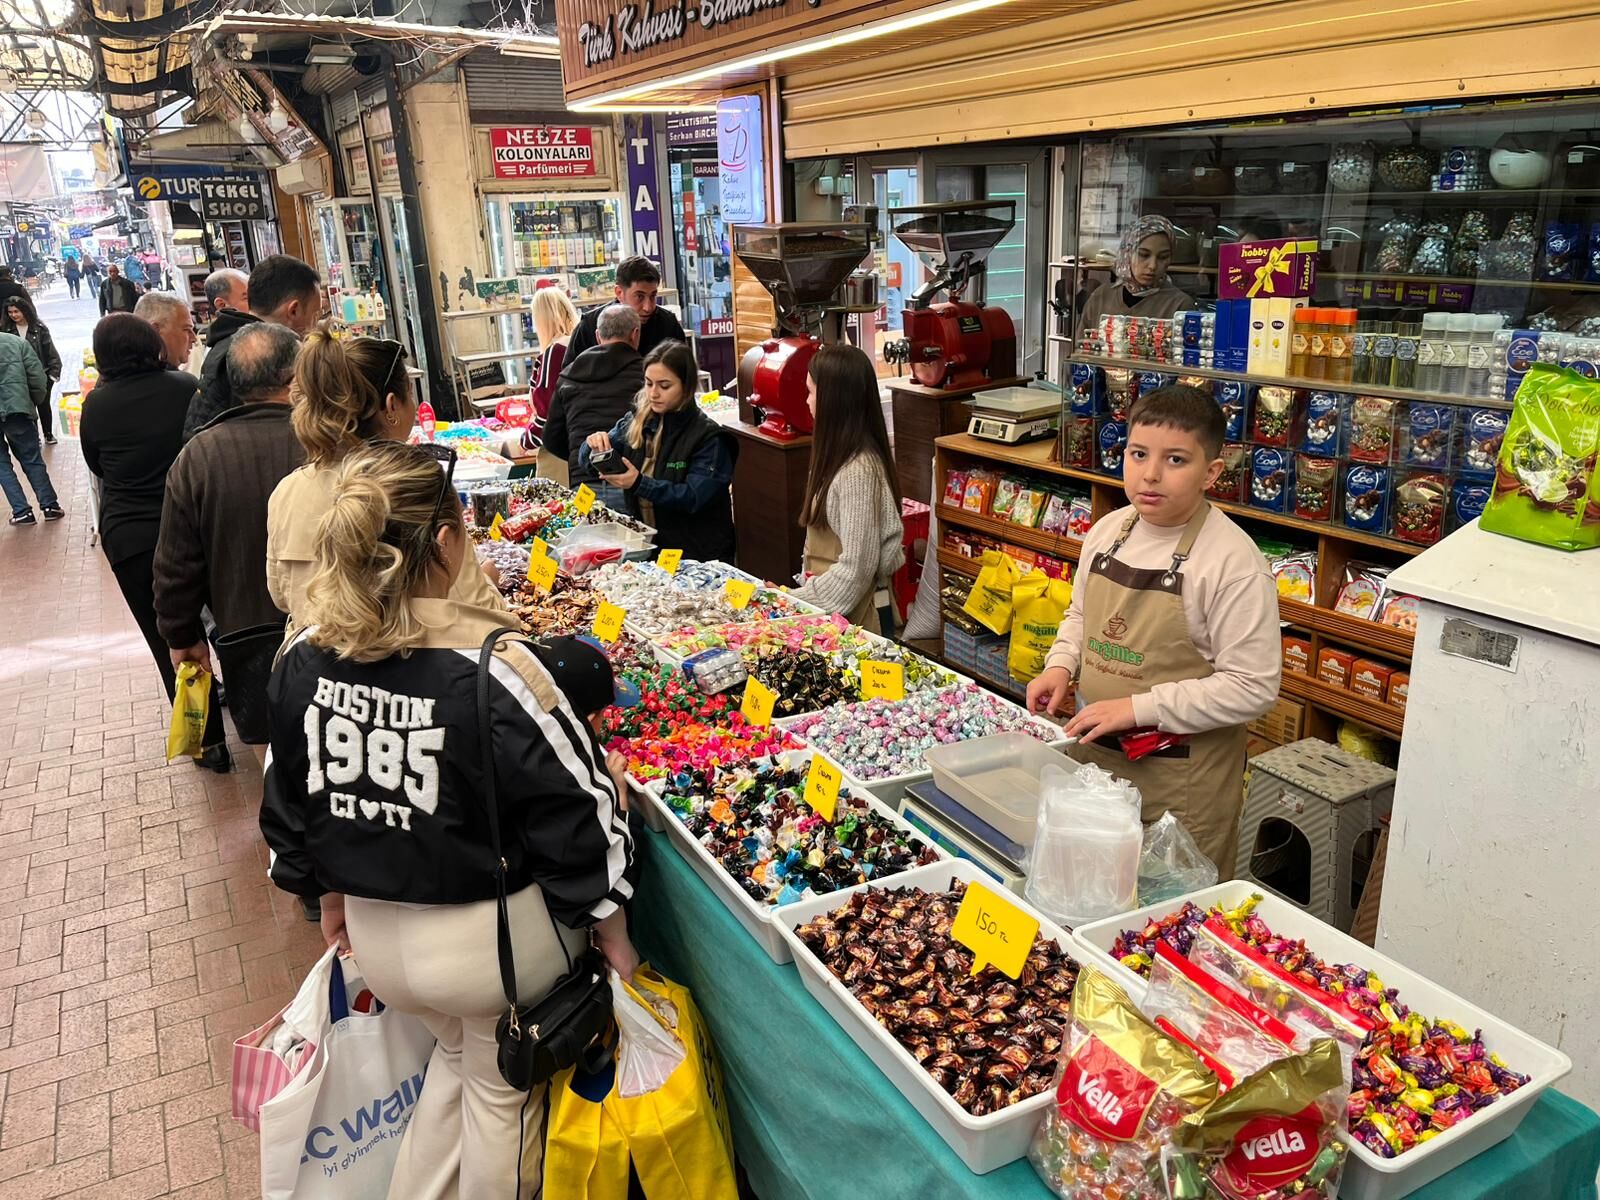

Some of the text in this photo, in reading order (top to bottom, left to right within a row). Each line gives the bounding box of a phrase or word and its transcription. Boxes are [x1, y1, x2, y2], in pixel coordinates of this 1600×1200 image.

[578, 16, 615, 66] Türk
[618, 0, 685, 53] Kahvesi
[506, 129, 577, 145] NEBZE
[496, 147, 590, 161] KOLONYALARI
[519, 162, 573, 176] Parfümeri
[204, 184, 259, 199] TEKEL
[208, 202, 259, 217] SHOP
[1241, 247, 1269, 258] hobby
[1303, 254, 1311, 291] hobby
[1511, 345, 1534, 356] Ece
[1310, 394, 1332, 406] Ece
[1255, 455, 1279, 467] Ece
[1351, 471, 1375, 484] Ece
[313, 676, 436, 730] BOSTON
[304, 703, 446, 816] 1985
[322, 1161, 338, 1177] iyi
[341, 1130, 387, 1170] giyinmek
